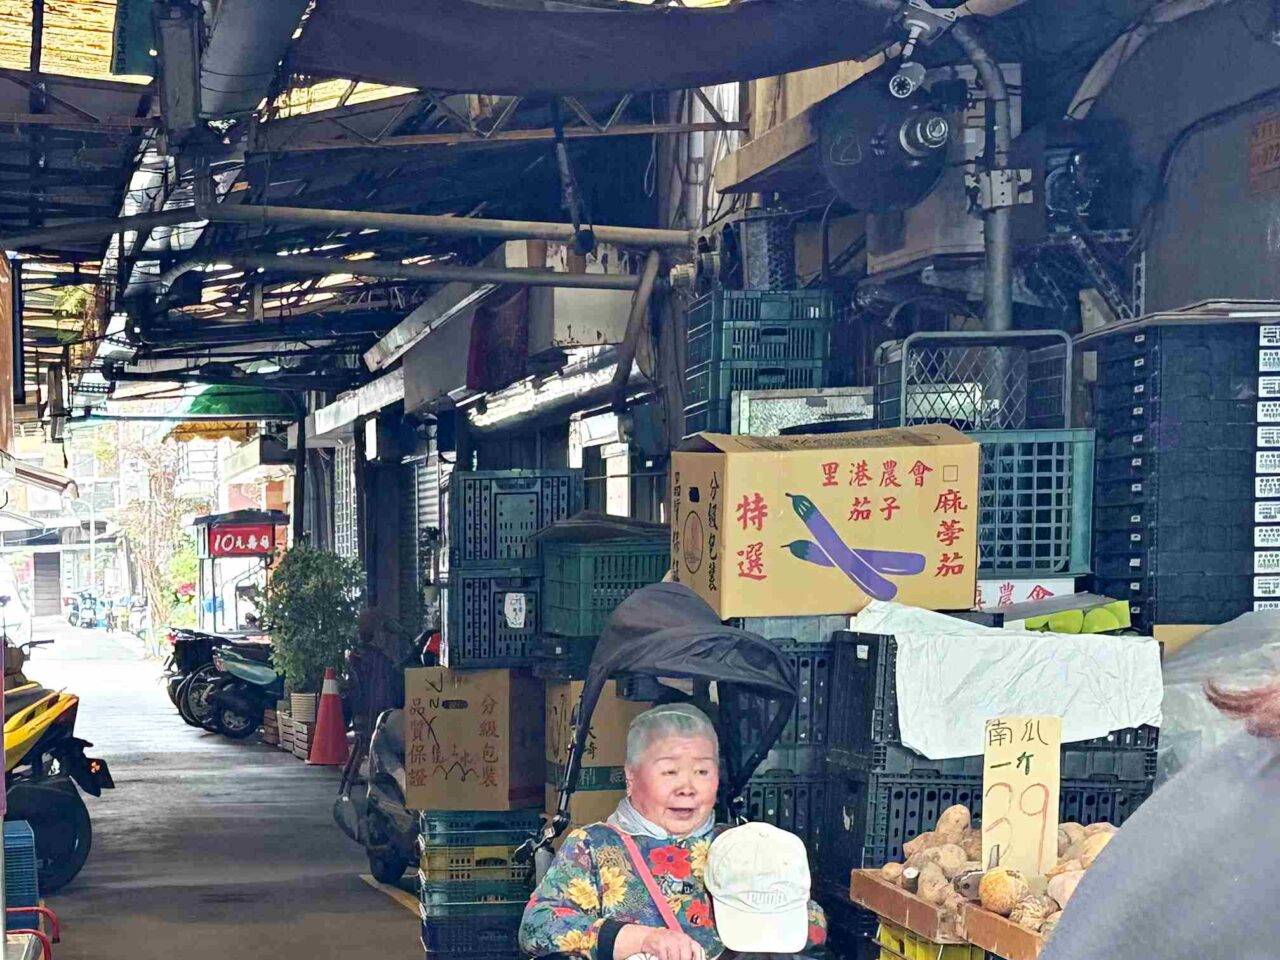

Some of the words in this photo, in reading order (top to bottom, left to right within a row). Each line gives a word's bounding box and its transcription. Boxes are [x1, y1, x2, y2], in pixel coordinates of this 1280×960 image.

[821, 459, 933, 488] 里港農會
[735, 492, 768, 582] 特選
[848, 497, 901, 522] 茄子
[479, 694, 500, 788] 分級包裝
[988, 719, 1049, 747] 南瓜
[985, 783, 1050, 875] 39
